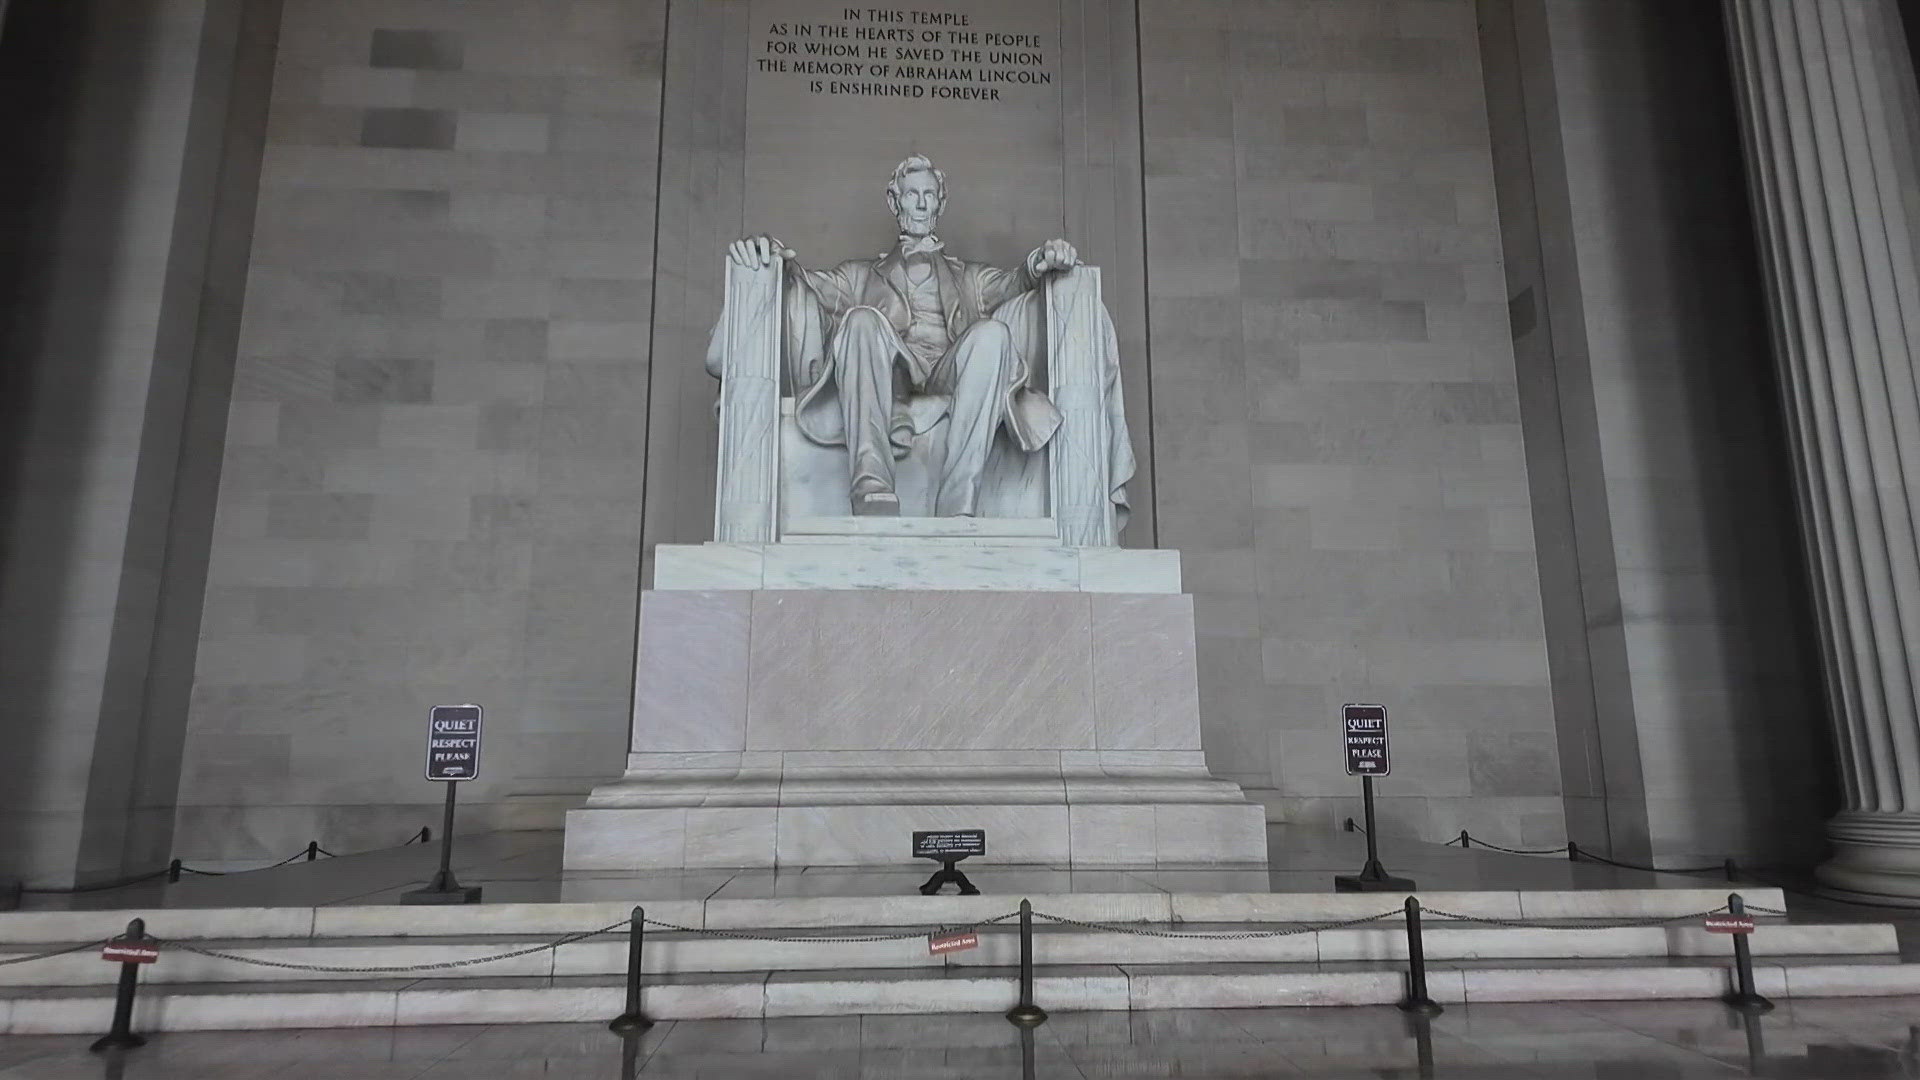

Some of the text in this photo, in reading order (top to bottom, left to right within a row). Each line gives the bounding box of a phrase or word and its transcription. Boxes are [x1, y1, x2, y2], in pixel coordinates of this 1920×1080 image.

[844, 8, 969, 26] IN THIS TEMPLE
[769, 23, 1041, 48] AS IN THE HEARTS OF THE PEOPLE
[767, 42, 1043, 65] FOR WHOM HE SAVED THE UNION
[757, 59, 1051, 85] THE MEMORY OF ABRAHAM LINCOLN
[810, 81, 1000, 101] IS ENSHRINED FOREVER
[435, 719, 476, 732] QUIET
[1348, 719, 1382, 731] QUIET
[432, 739, 476, 748] RESPECT
[1352, 749, 1382, 758] PLEASE
[932, 939, 960, 950] Restricted
